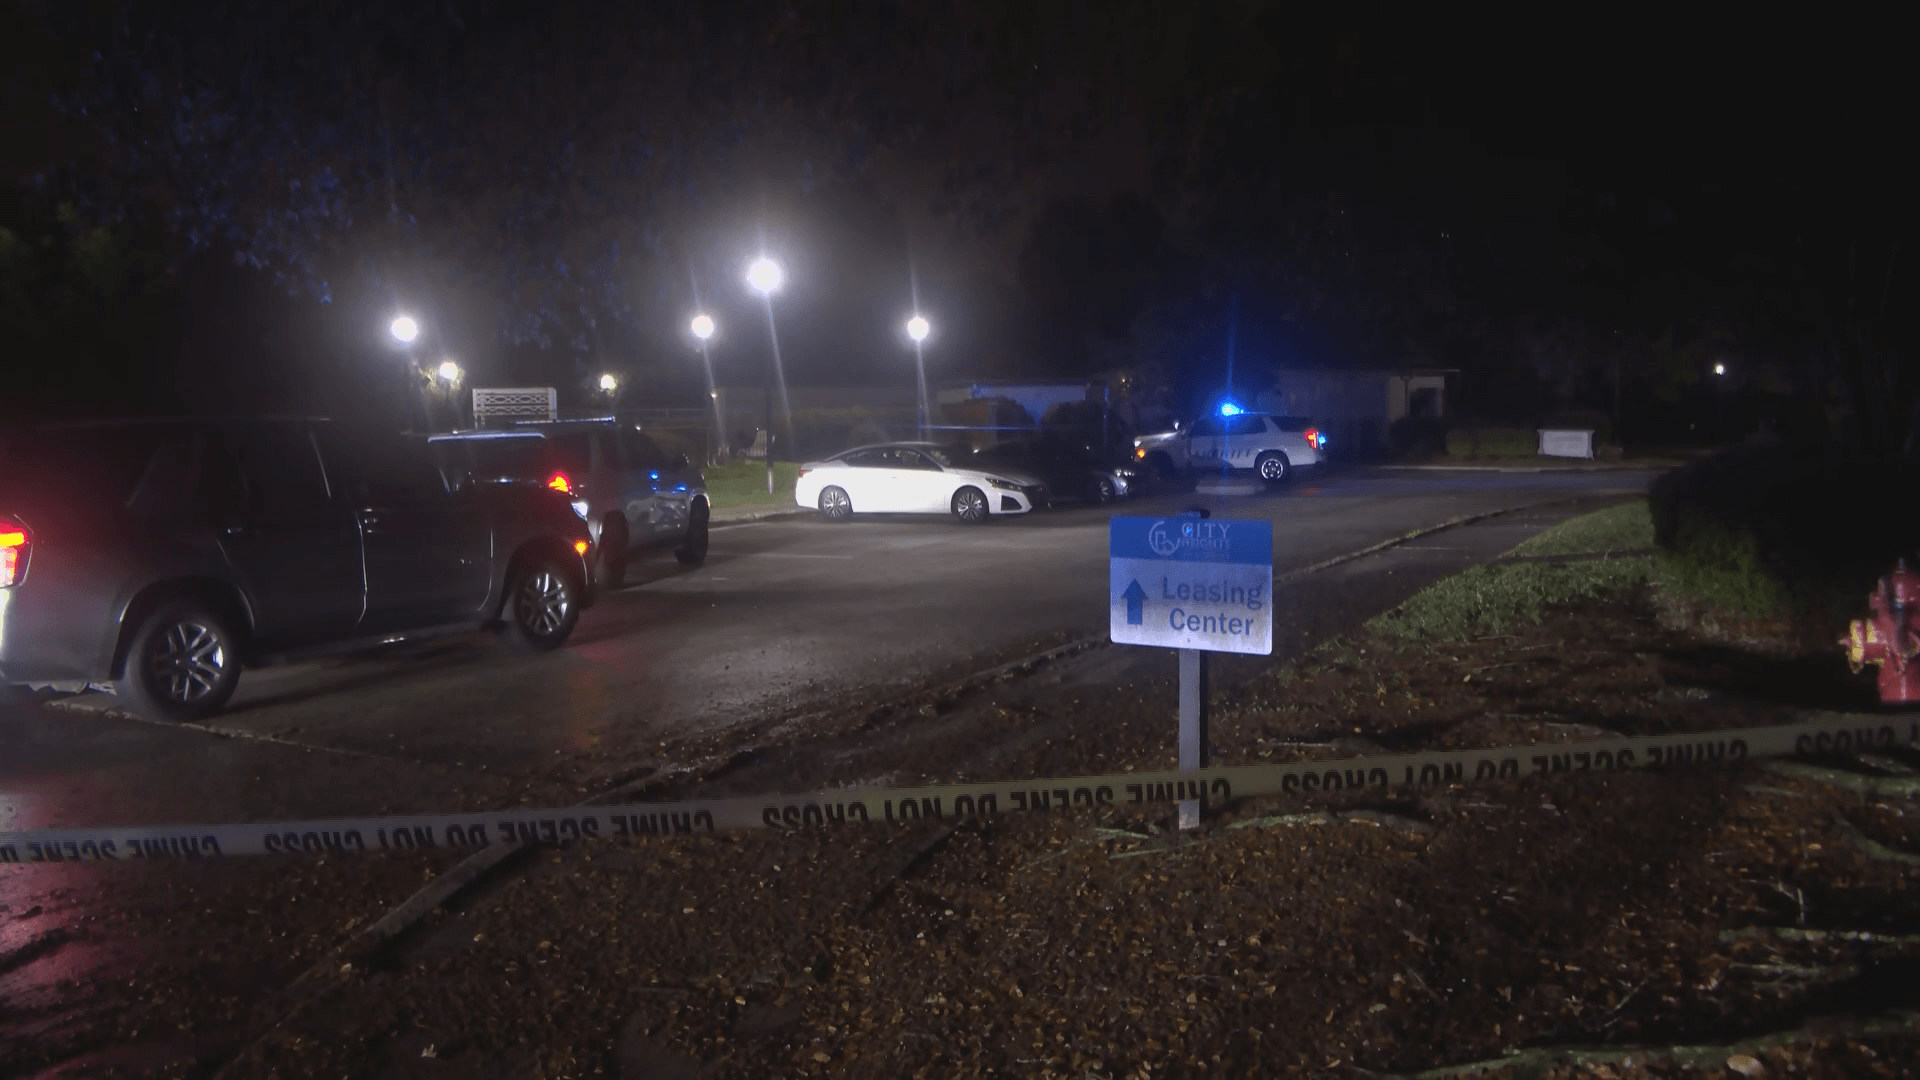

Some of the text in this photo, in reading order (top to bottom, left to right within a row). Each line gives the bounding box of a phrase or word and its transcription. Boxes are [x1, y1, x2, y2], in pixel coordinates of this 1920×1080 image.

[1182, 522, 1230, 538] CITY
[1162, 575, 1263, 610] Leasing
[1169, 607, 1254, 636] Center
[954, 793, 998, 817] DO
[1010, 785, 1114, 811] SCENE
[446, 823, 490, 848] DO
[497, 817, 600, 844] SCENE
